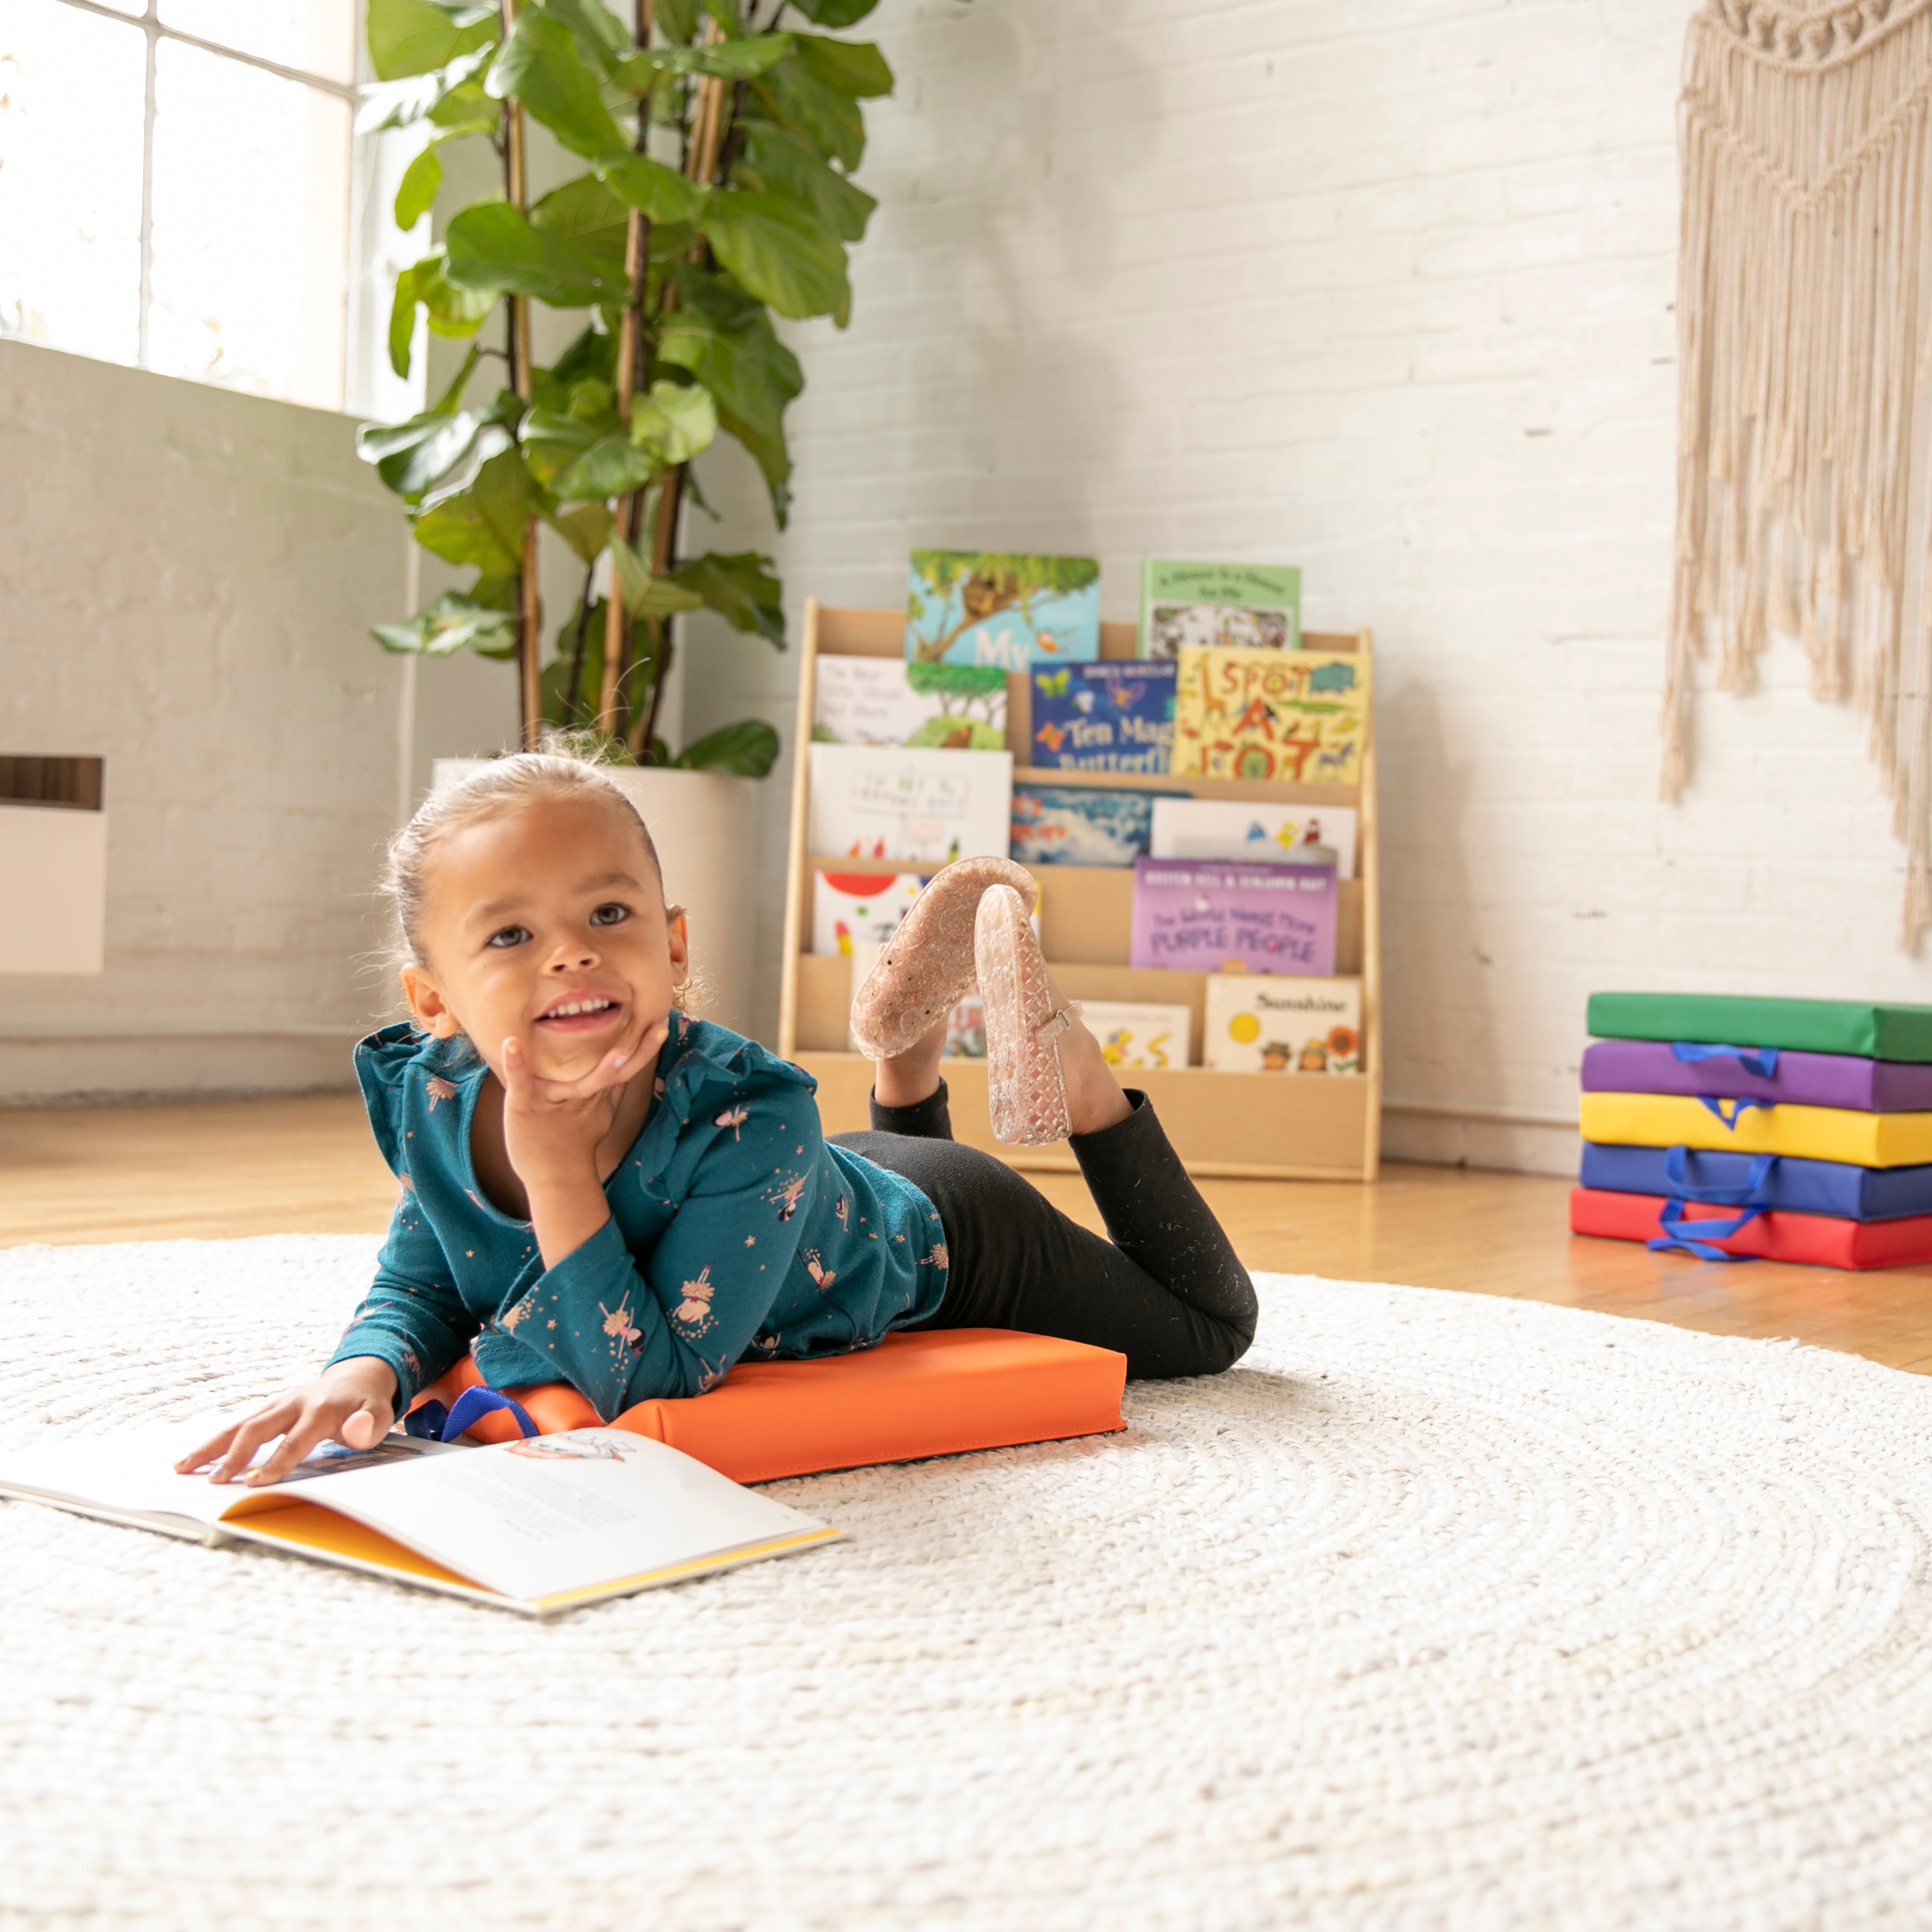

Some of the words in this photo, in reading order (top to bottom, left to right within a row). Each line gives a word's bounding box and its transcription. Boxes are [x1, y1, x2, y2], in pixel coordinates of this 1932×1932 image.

[1221, 660, 1311, 697] SPOT
[1064, 717, 1113, 748] Ten
[1232, 698, 1273, 741] A
[1150, 926, 1227, 954] PURPLE
[1235, 927, 1315, 964] PEOPLE
[1256, 992, 1348, 1012] Sunshine
